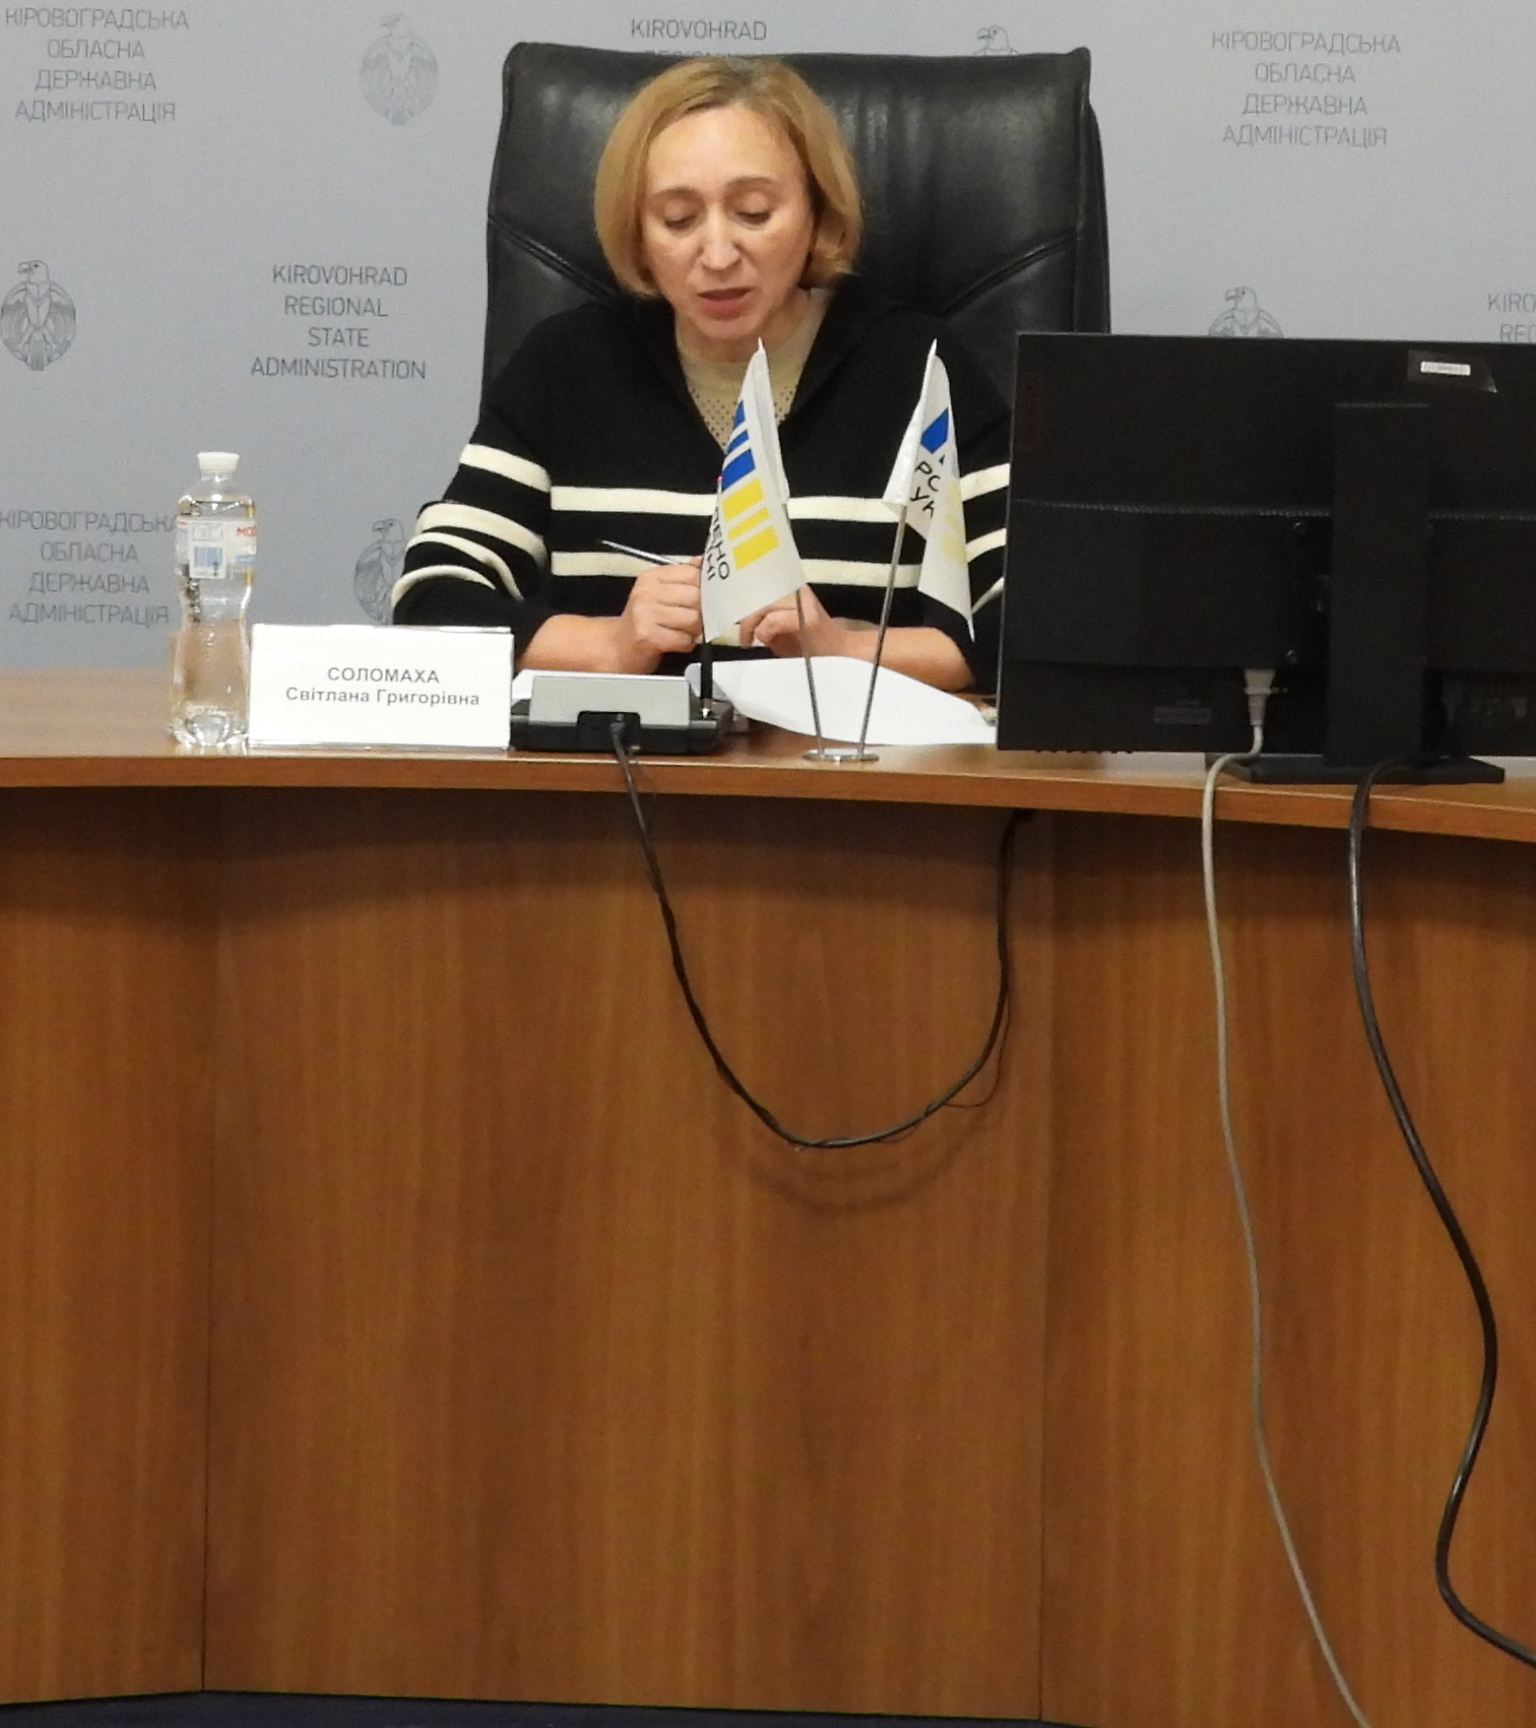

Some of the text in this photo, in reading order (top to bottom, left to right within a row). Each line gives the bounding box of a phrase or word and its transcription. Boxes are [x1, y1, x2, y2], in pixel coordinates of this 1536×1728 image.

[5, 7, 190, 31] КІРОВОГРАДСЬКА
[630, 18, 767, 40] KIROVOHRAD
[47, 38, 145, 59] ОБЛАСНА
[1211, 30, 1401, 56] КІРОВОГРАДСЬКА
[34, 69, 157, 92] ДЕРЖАВНА
[1254, 62, 1356, 84] ОБЛАСНА
[14, 99, 176, 124] АДМІНІСТРАЦІЯ
[1242, 93, 1368, 116] ДЕРЖАВНА
[1222, 123, 1387, 150] АДМІНІСТРАЦІЯ
[272, 263, 408, 287] KIROVOHRAD
[284, 294, 389, 318] REGIONAL
[307, 325, 370, 348] STATE
[250, 356, 427, 380] ADMINISTRATION
[40, 541, 138, 562] ОБЛАСНА
[27, 571, 150, 595] ДЕРЖАВНА
[9, 602, 170, 628] АДМІНІСТРАЦІЯ
[327, 667, 440, 684] СОЛОМАХА
[286, 686, 480, 708] Світлана Григорівна
